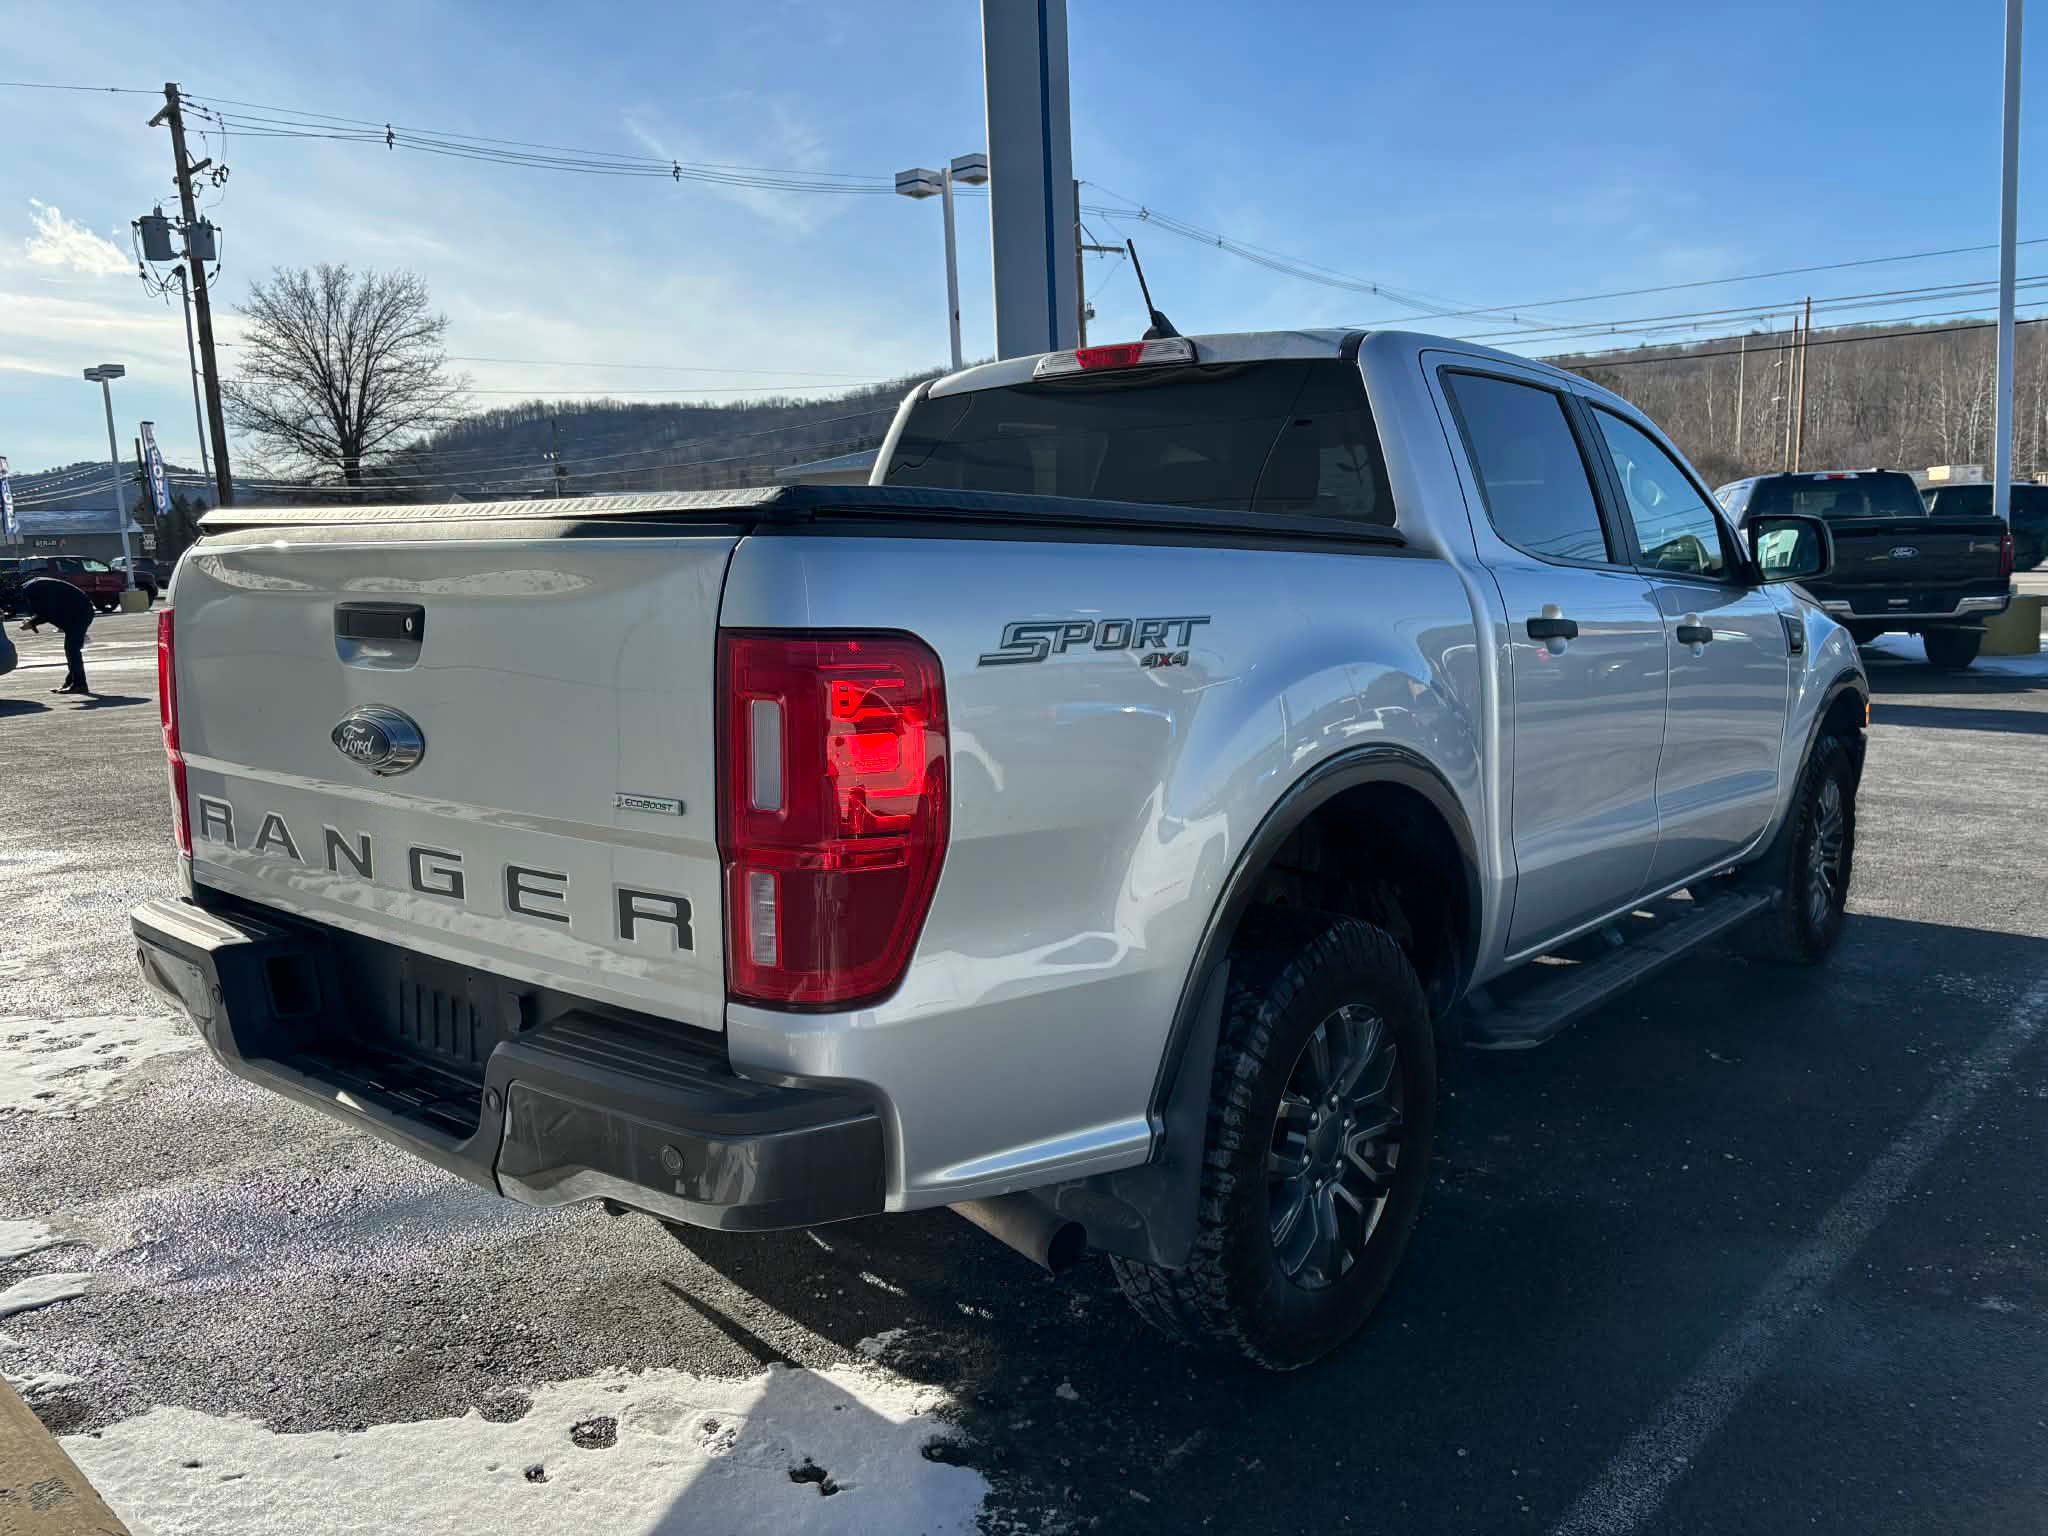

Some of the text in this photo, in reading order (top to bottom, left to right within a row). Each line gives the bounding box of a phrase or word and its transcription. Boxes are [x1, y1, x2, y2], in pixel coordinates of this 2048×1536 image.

[977, 616, 1211, 666] SPORT
[340, 725, 375, 755] Ford
[198, 796, 696, 952] RANGER
